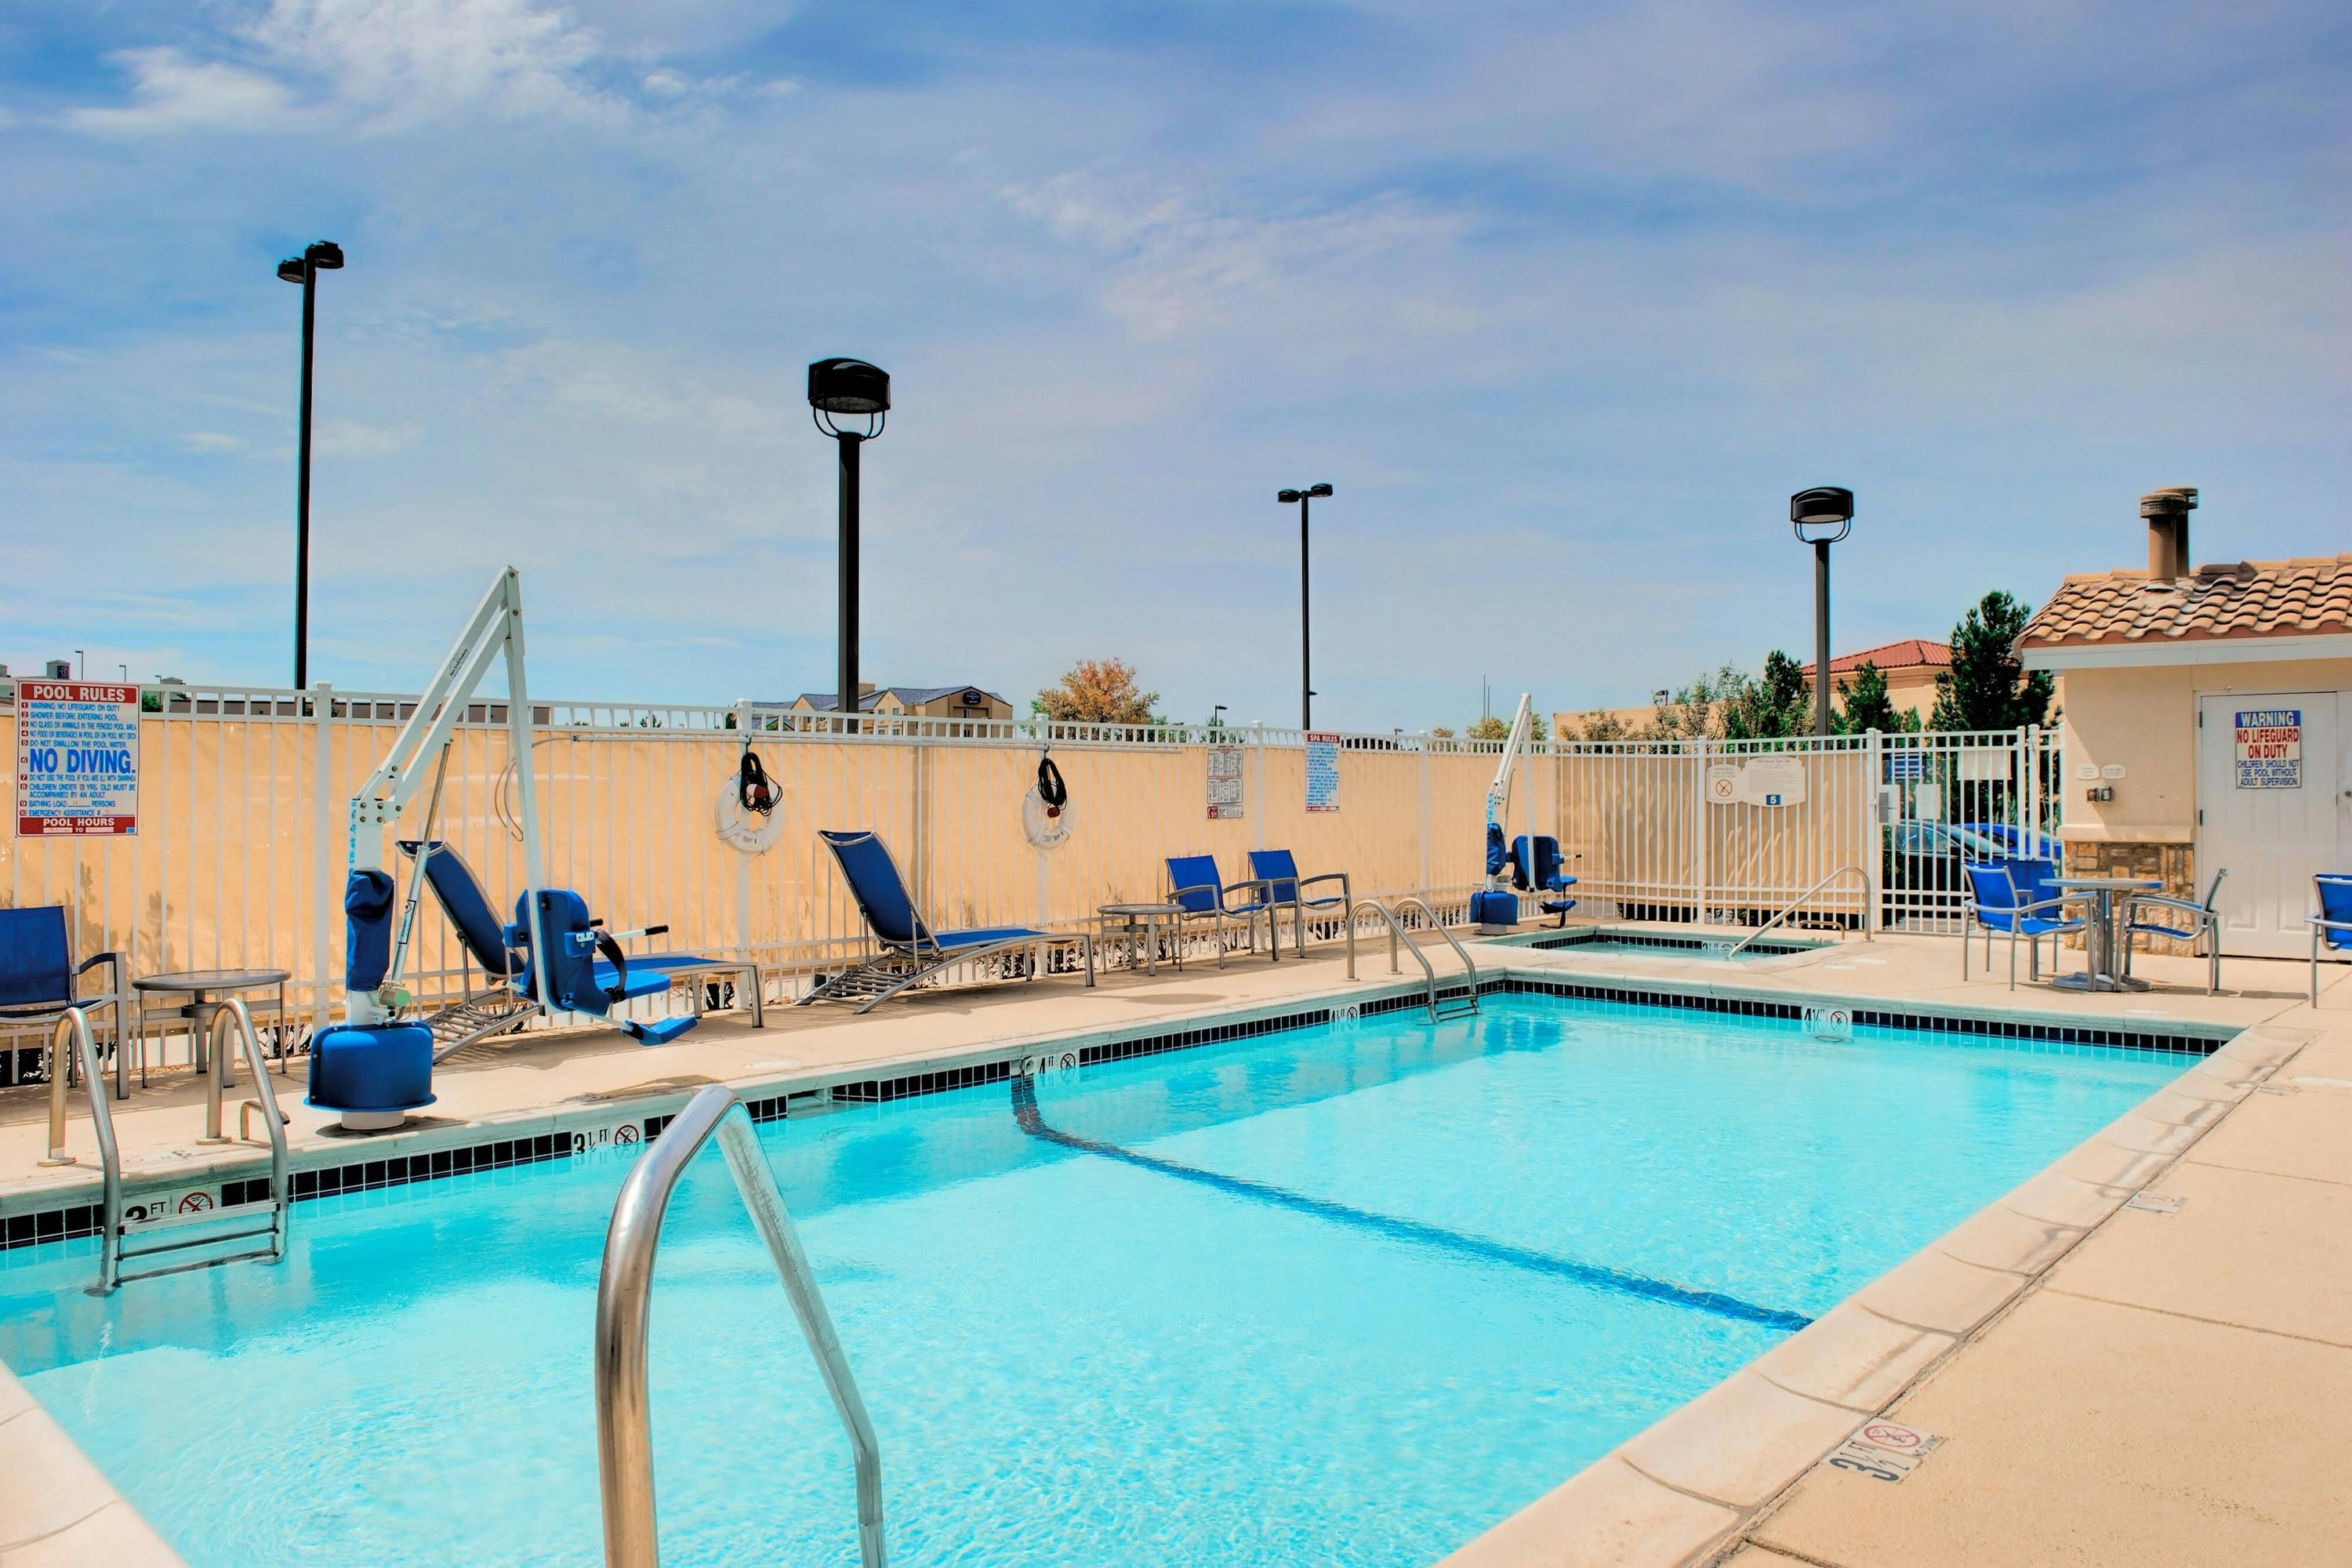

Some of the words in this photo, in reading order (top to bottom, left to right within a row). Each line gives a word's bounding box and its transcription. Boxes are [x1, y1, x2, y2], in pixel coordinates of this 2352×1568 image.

[34, 685, 74, 699] POOL
[79, 687, 125, 702] RULES
[2241, 711, 2295, 728] WARNING
[2237, 729, 2249, 743] NO
[2252, 728, 2299, 743] LIFEGUARD
[2248, 745, 2261, 759] ON
[2263, 744, 2288, 758] DUTY
[30, 749, 58, 773] NO
[67, 750, 136, 774] DIVING.
[2237, 760, 2263, 768] CHILDREN
[2265, 760, 2287, 768] SHOULD
[2288, 759, 2299, 768] NOT
[2254, 768, 2270, 777] POOL
[2260, 777, 2297, 786] SUPERVISION
[1048, 1056, 1054, 1066] FT
[574, 1133, 585, 1154] 3
[600, 1129, 608, 1142] FT
[151, 1201, 166, 1214] FT
